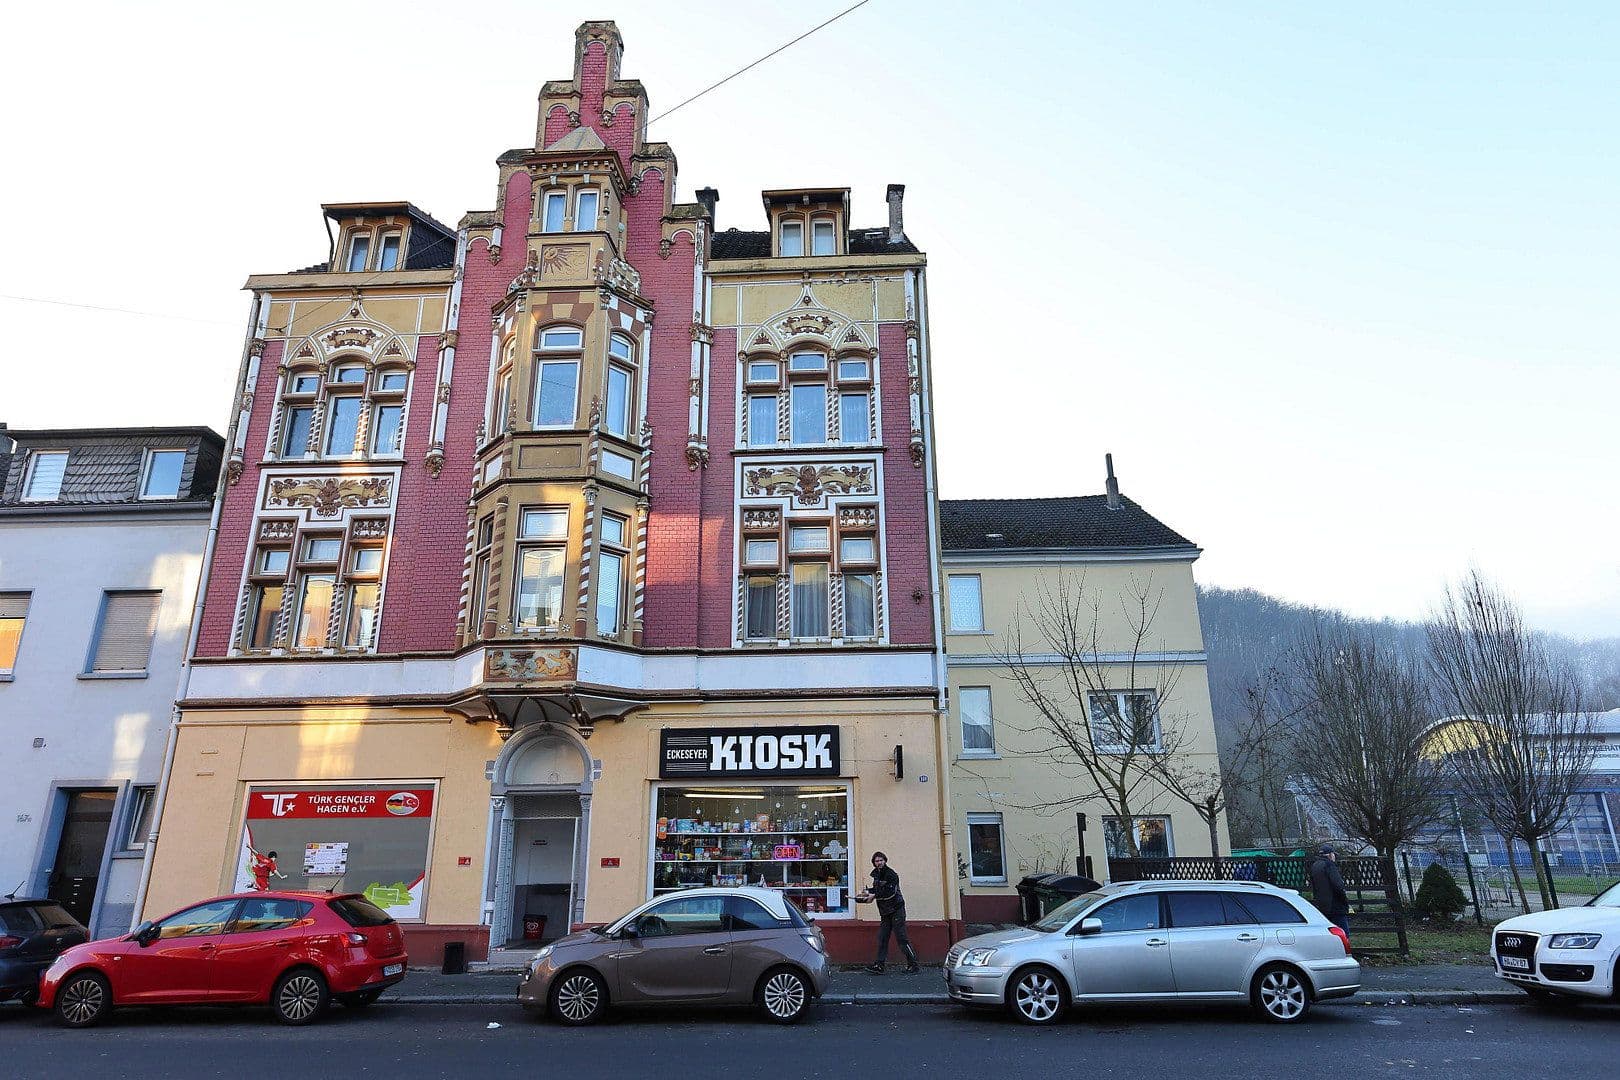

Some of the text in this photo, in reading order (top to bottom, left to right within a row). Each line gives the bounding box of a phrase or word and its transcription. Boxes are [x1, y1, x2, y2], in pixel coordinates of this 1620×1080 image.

[666, 733, 833, 771] ECKESEYER KIOSK
[308, 794, 376, 805] TÜRK GENÇLER
[316, 805, 367, 814] HAGEN e.V.
[776, 847, 799, 858] OPEN
